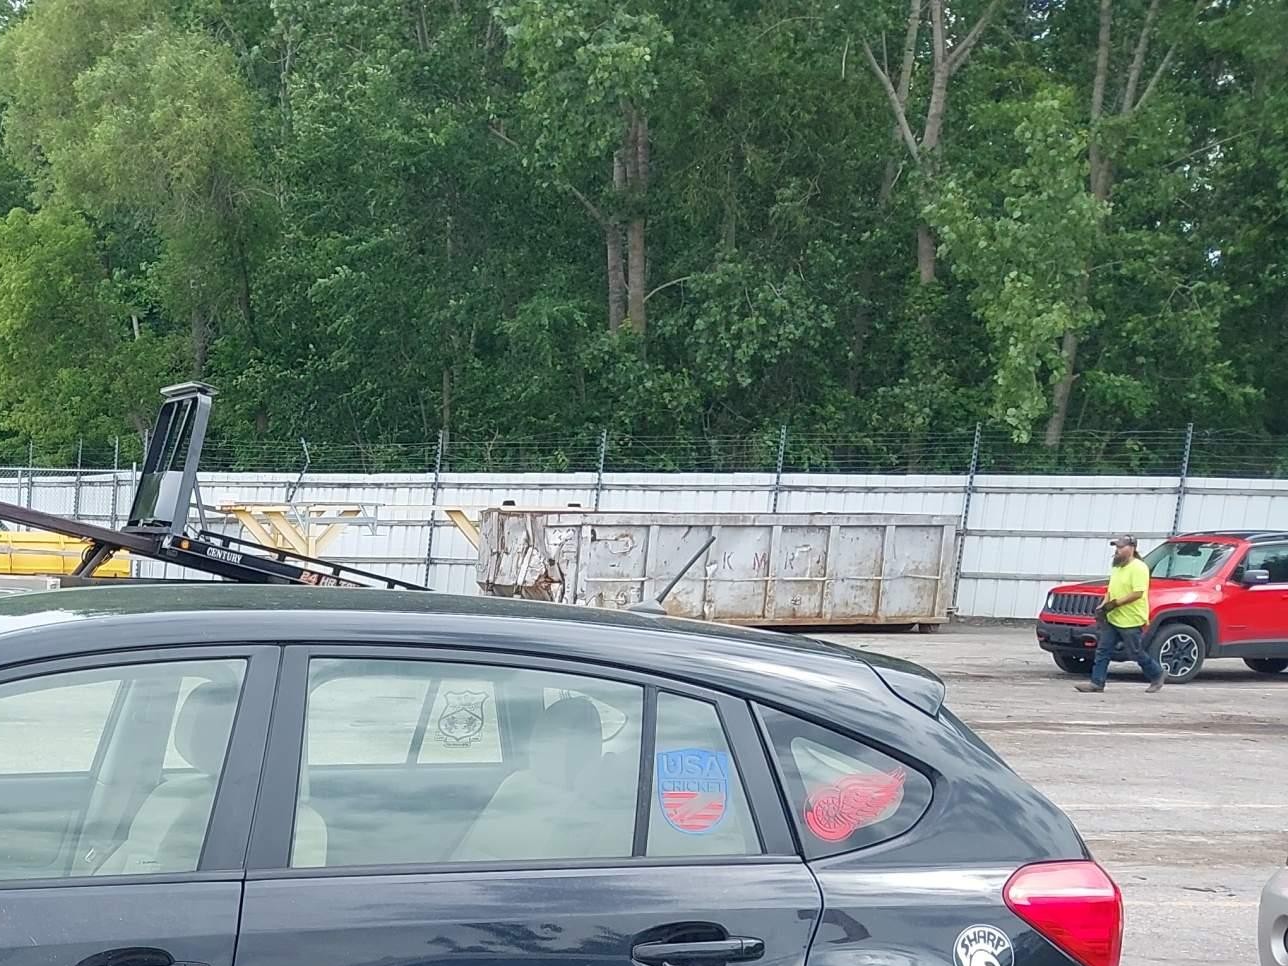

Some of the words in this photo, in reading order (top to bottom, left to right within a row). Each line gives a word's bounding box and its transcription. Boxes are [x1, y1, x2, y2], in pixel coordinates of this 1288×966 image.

[206, 546, 243, 565] CENTURY
[300, 570, 319, 586] 24
[662, 753, 726, 778] USA
[661, 780, 721, 793] CRICKET
[960, 929, 1006, 957] SHARP
